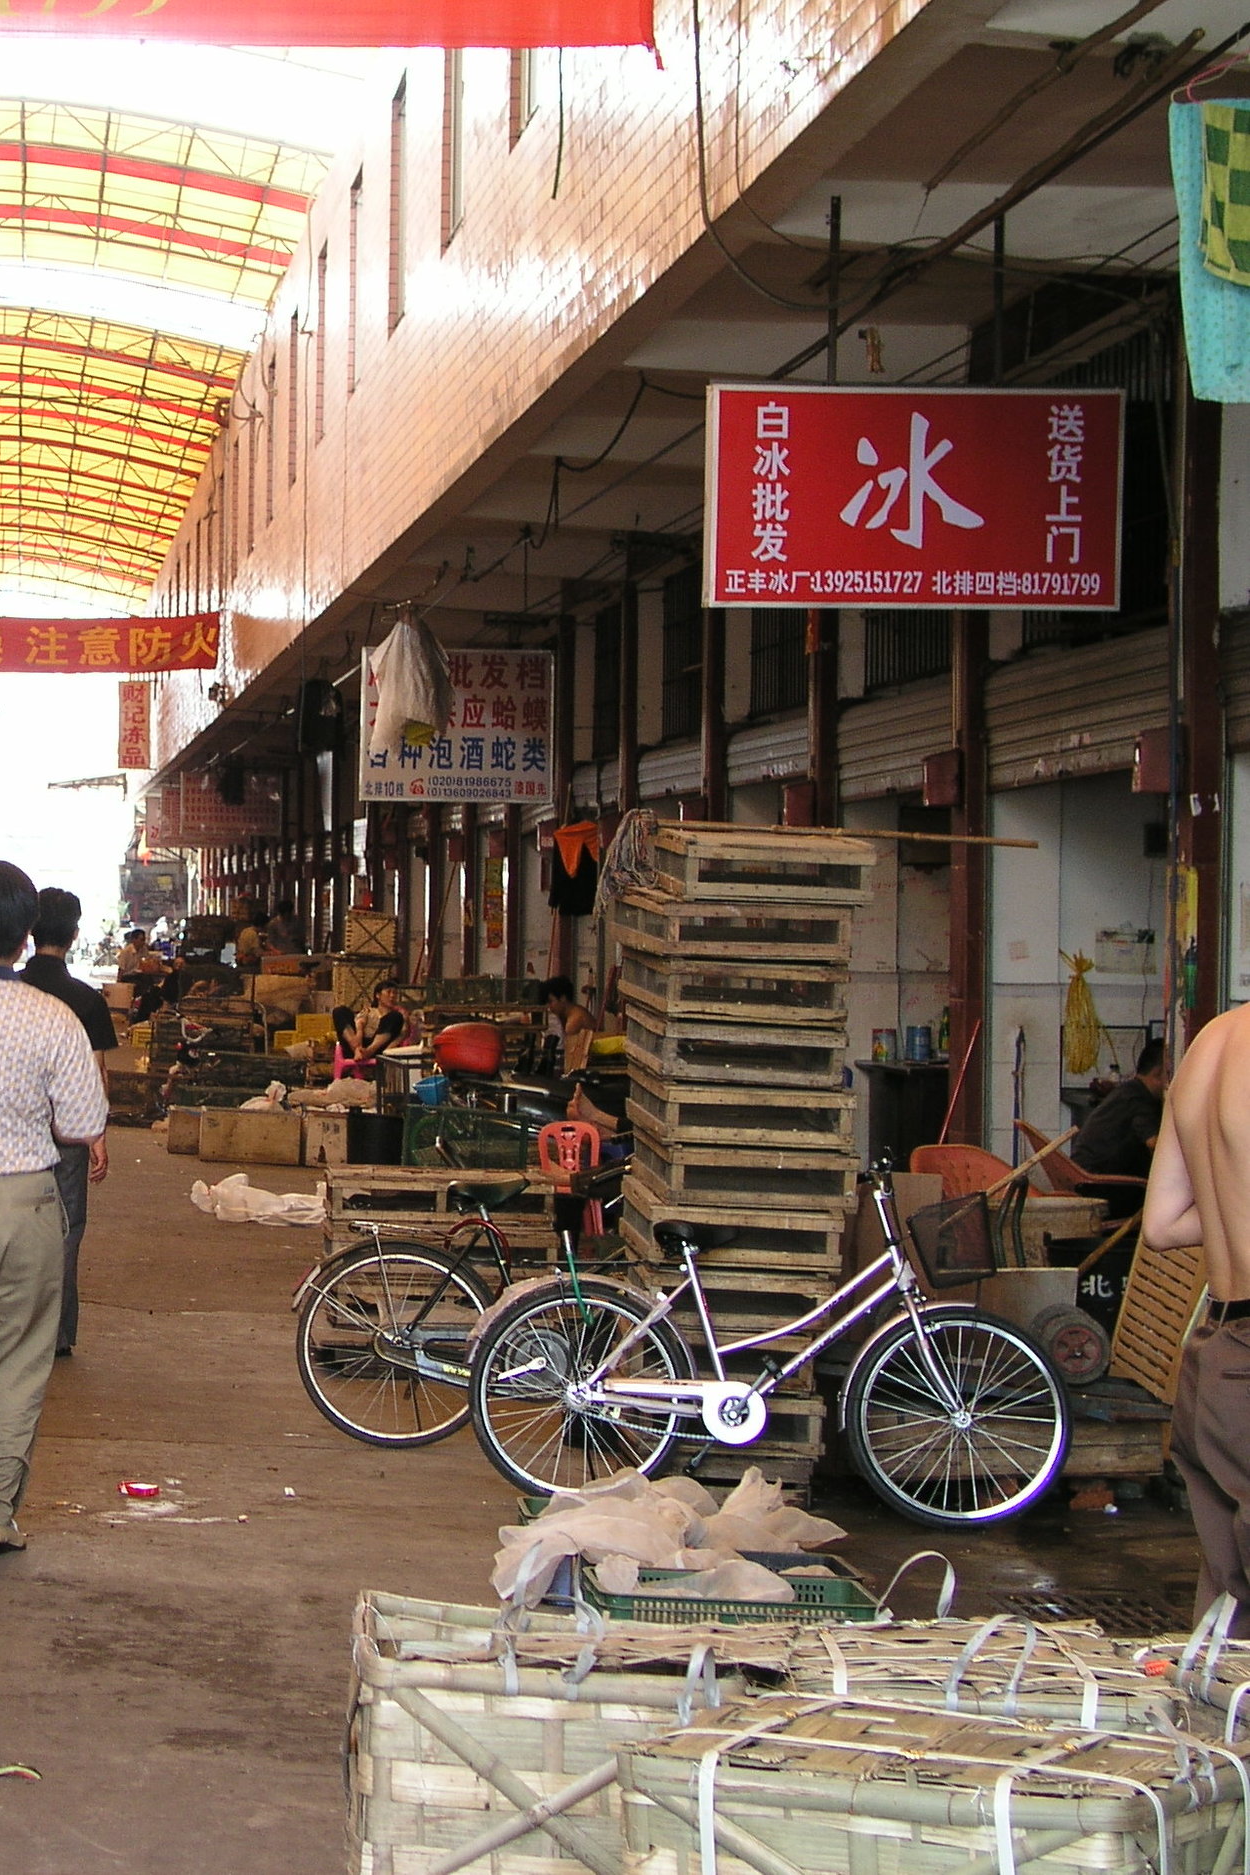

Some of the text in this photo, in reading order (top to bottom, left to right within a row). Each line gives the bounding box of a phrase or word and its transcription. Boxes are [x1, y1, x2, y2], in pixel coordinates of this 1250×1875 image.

[751, 401, 791, 563] 白冰批发
[839, 411, 985, 549] 冰
[1045, 404, 1086, 565] 送货上门
[25, 623, 219, 667] 注意防火
[932, 571, 1101, 598] 北排四档:81791799
